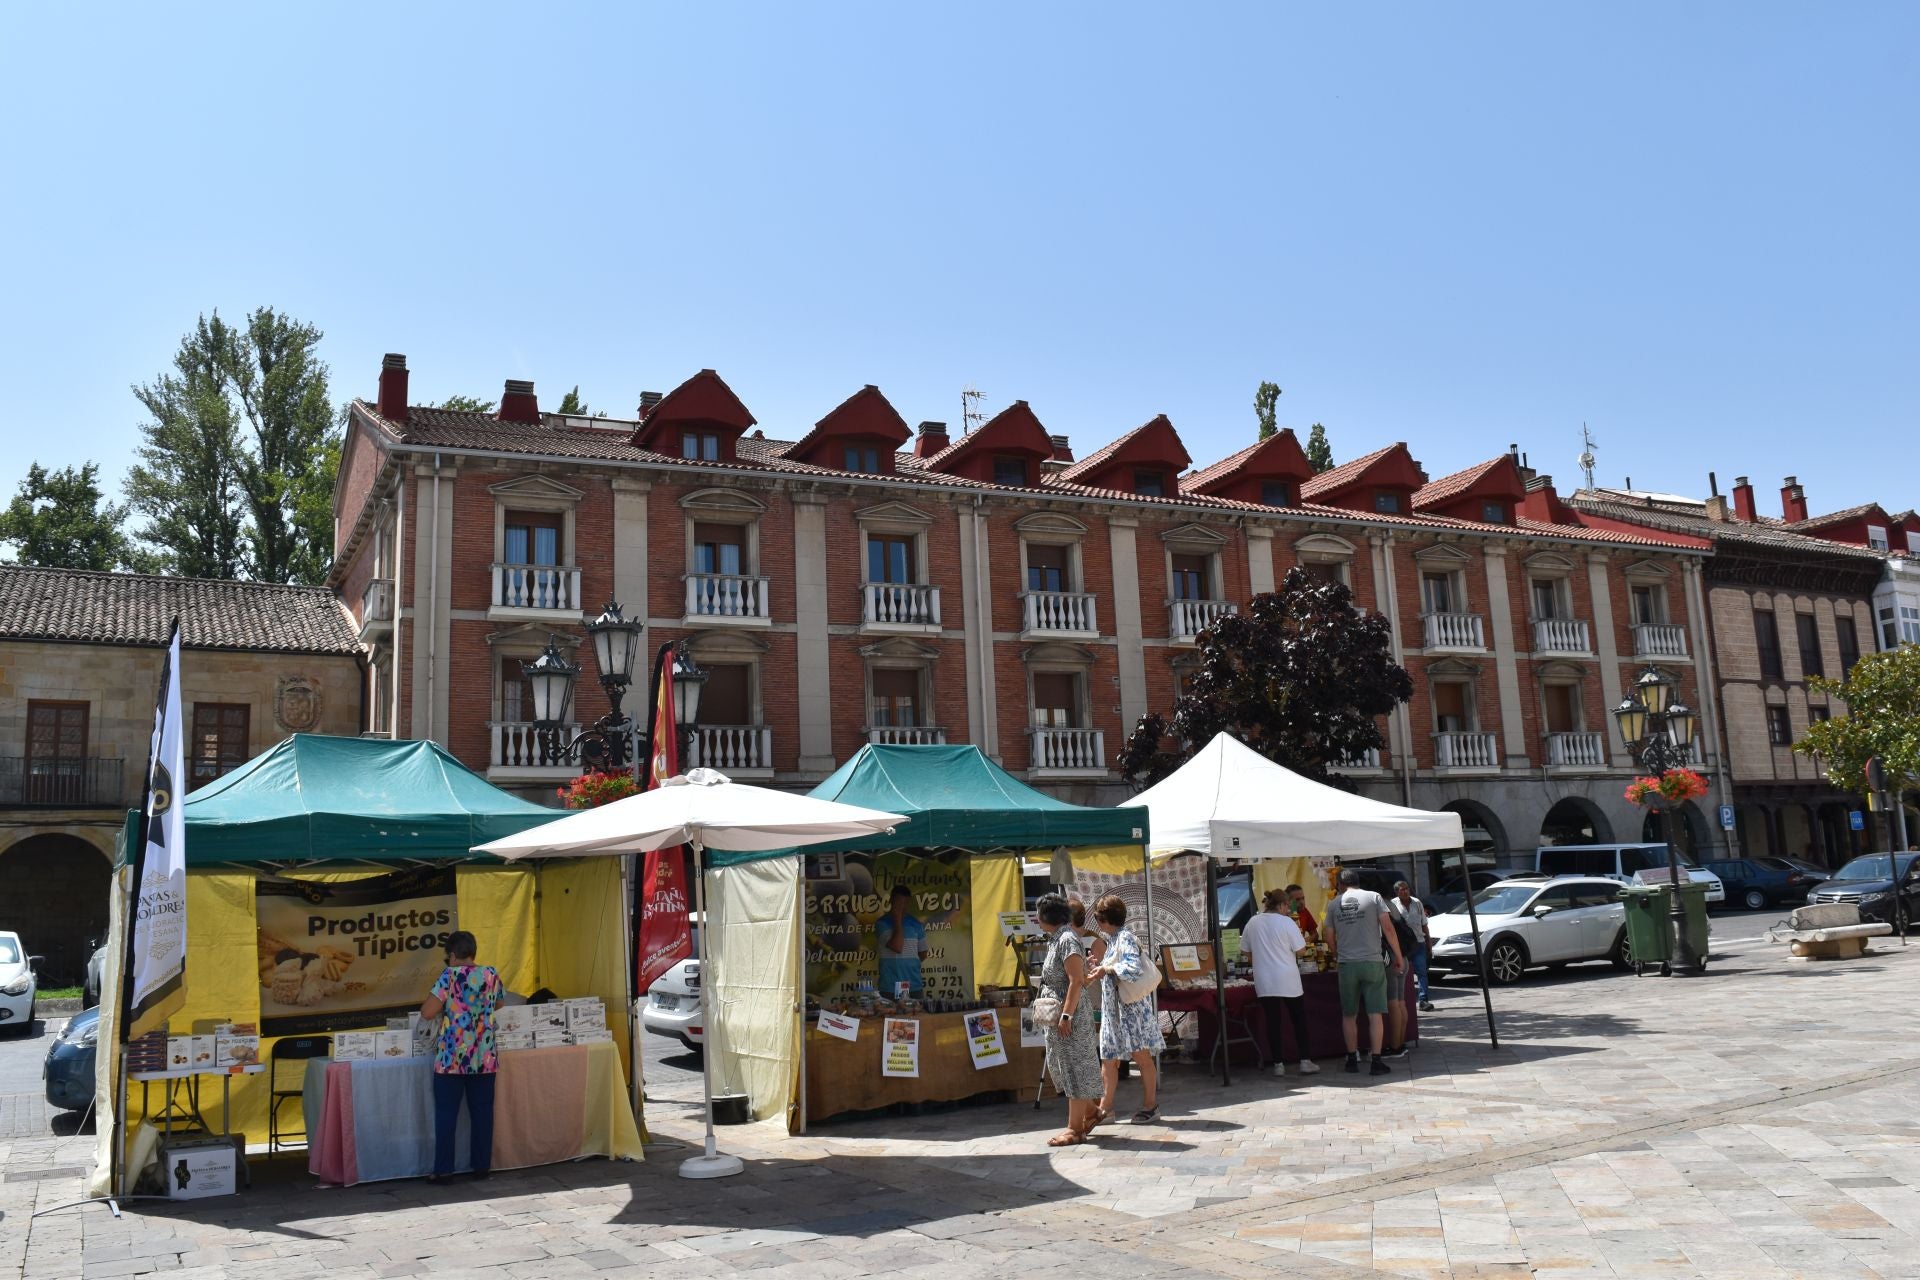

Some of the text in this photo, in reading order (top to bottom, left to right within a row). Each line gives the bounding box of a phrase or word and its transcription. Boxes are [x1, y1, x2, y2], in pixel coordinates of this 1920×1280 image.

[1723, 808, 1731, 823] P
[915, 891, 960, 911] VECI
[308, 909, 450, 937] Productos
[808, 924, 844, 935] VENTA
[847, 924, 862, 934] DE
[924, 922, 952, 931] ANTA
[353, 930, 451, 959] Típicos
[825, 950, 878, 966] campo
[920, 965, 957, 975] omicilio
[942, 975, 963, 986] 721
[938, 988, 964, 999] 794
